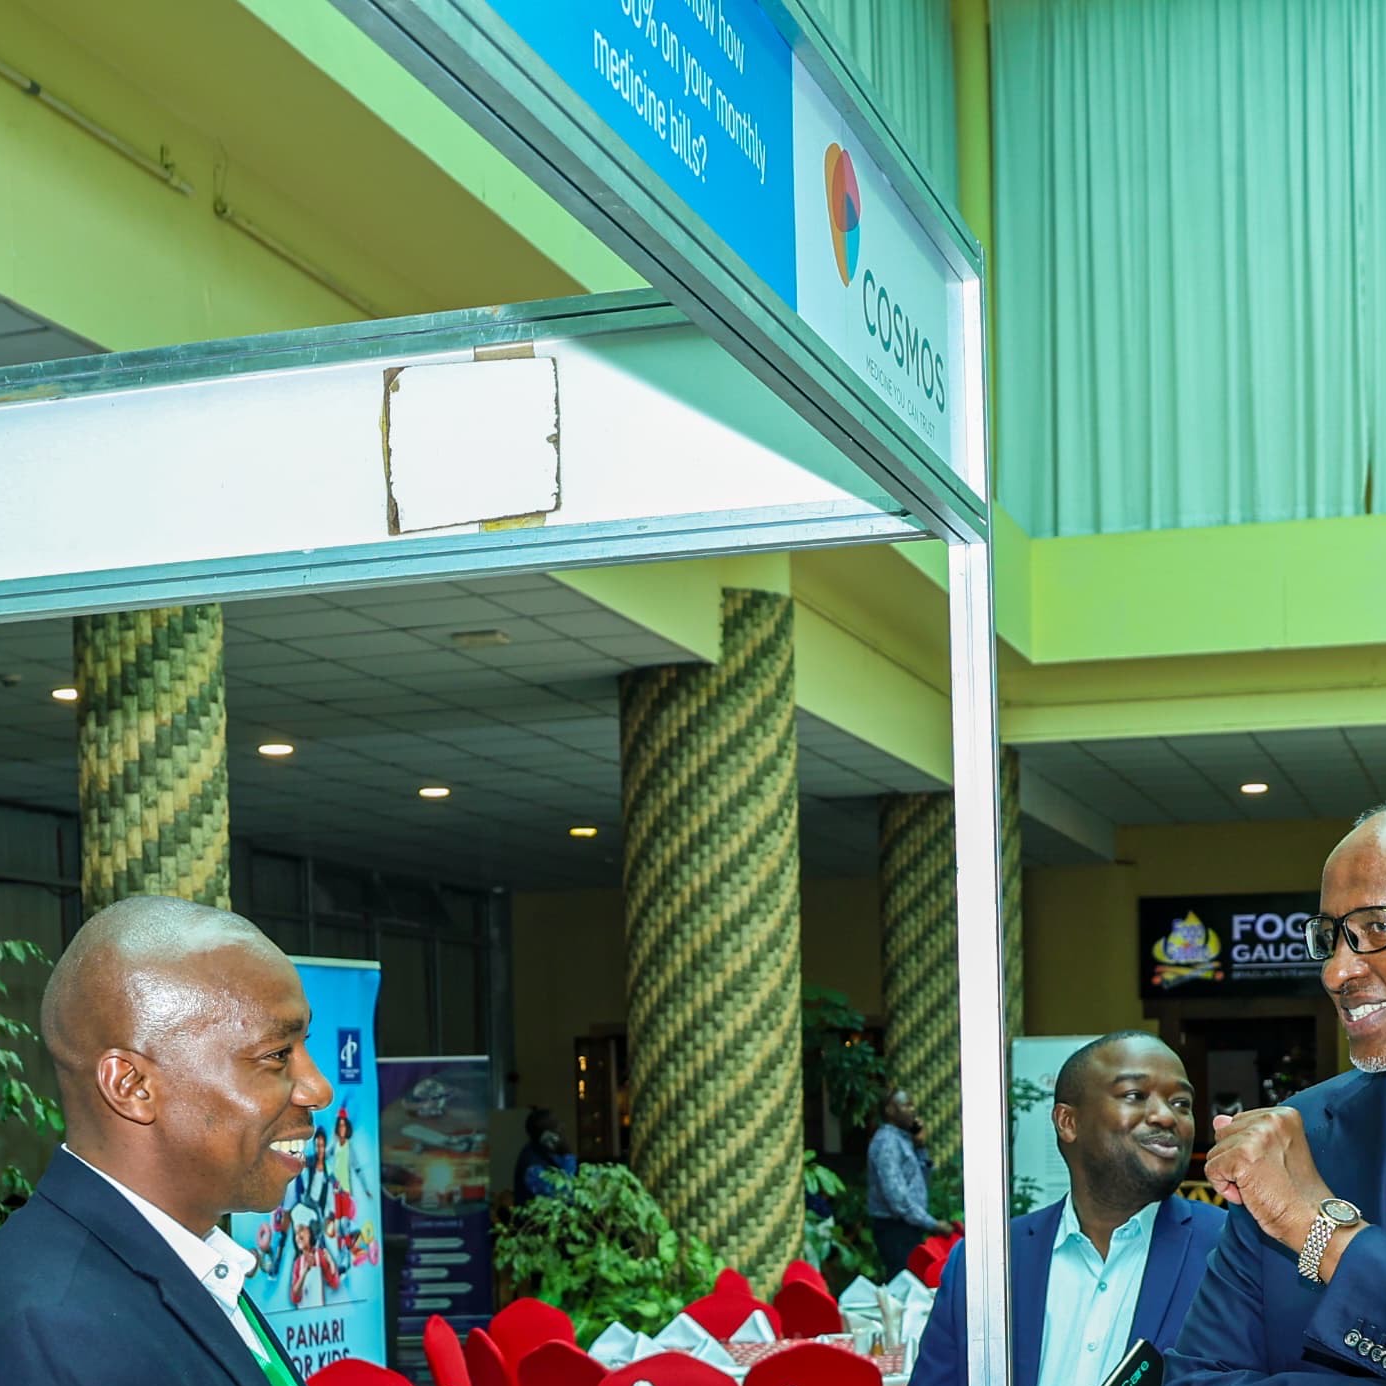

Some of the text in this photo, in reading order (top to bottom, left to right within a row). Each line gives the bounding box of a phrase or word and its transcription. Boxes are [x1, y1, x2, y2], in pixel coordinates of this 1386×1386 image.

[718, 0, 744, 75] how
[593, 28, 707, 183] medicine bills?
[661, 22, 679, 74] on
[683, 46, 712, 111] your
[716, 88, 766, 185] monthly
[863, 269, 945, 414] COSMOS
[866, 355, 935, 440] MEDICINE YOU CAN TRUST
[1232, 912, 1310, 941] FOG
[1232, 942, 1309, 963] GAUC
[286, 1318, 345, 1350] PANARI
